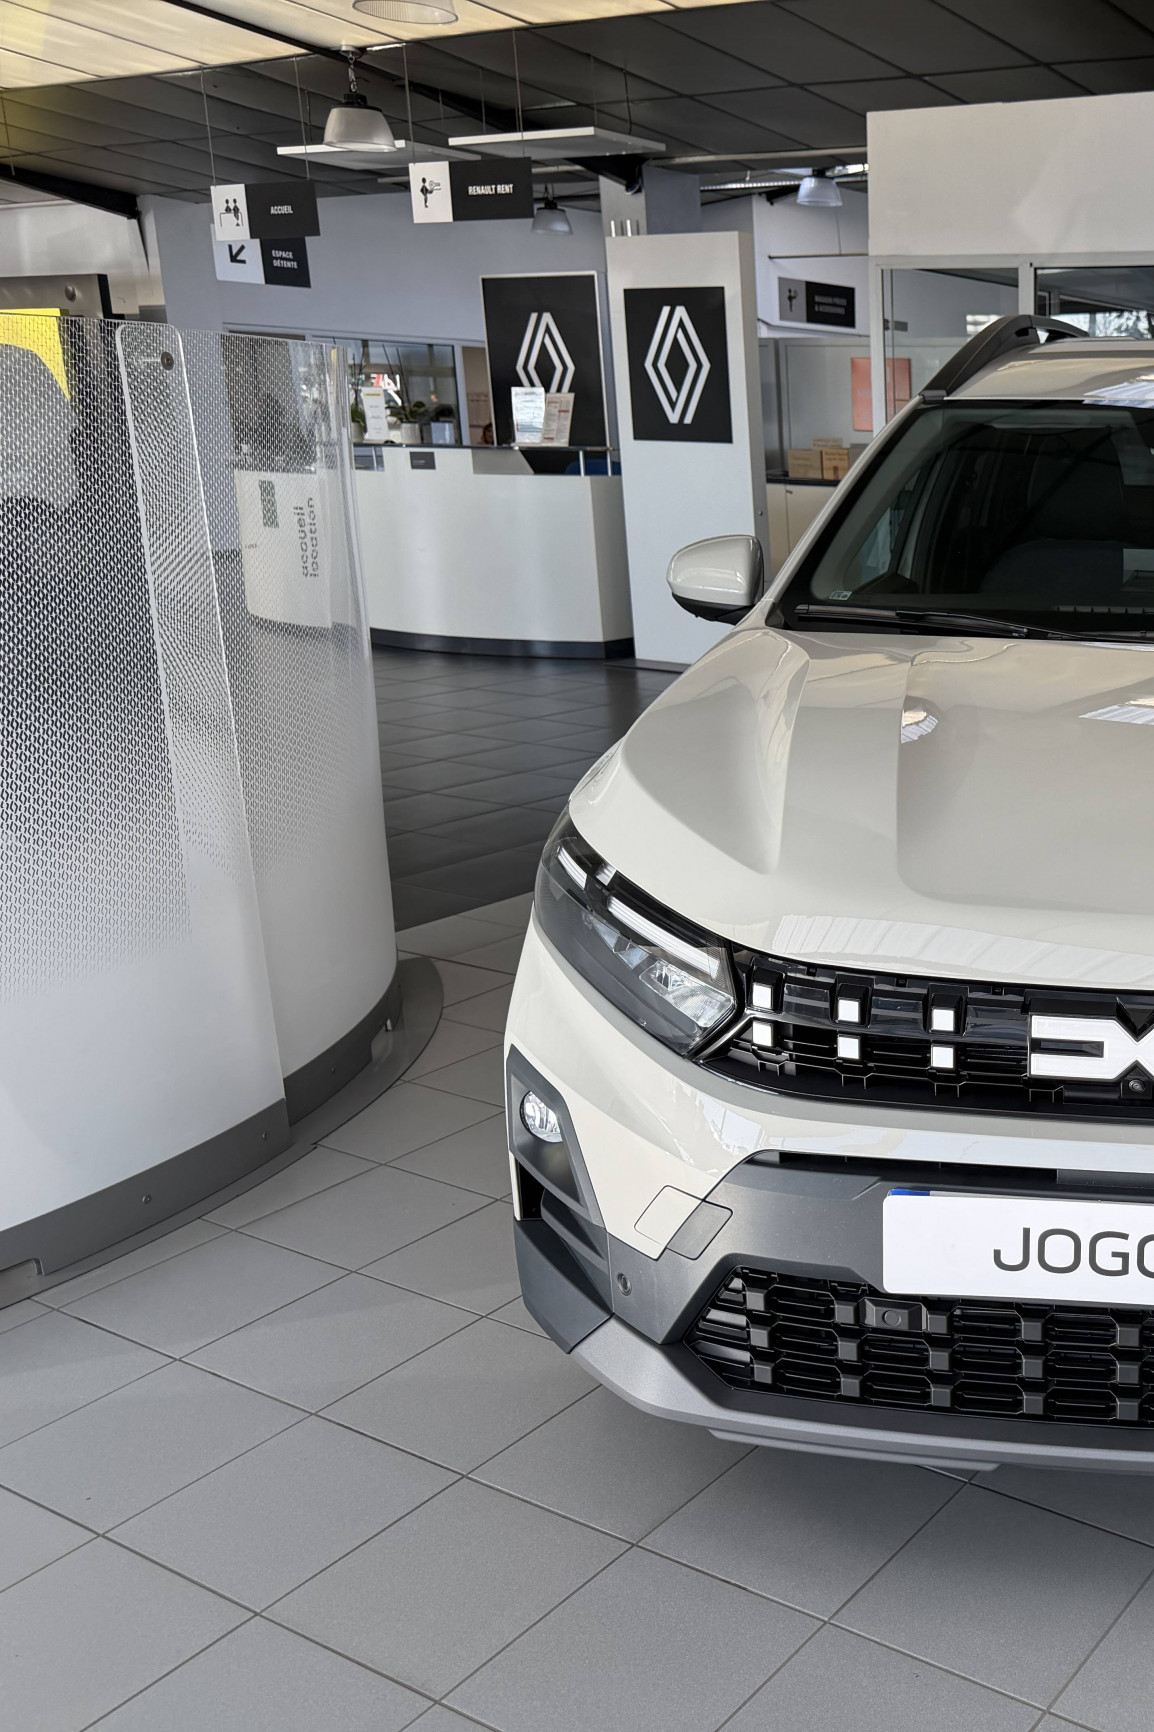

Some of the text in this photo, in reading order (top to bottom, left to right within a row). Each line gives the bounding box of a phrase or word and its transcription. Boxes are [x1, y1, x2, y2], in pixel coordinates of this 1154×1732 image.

[468, 184, 514, 195] RENAULT RENT
[270, 205, 293, 215] ACCUEIL
[272, 250, 293, 259] ESPACE
[293, 506, 309, 577] accueil
[308, 498, 319, 577] location
